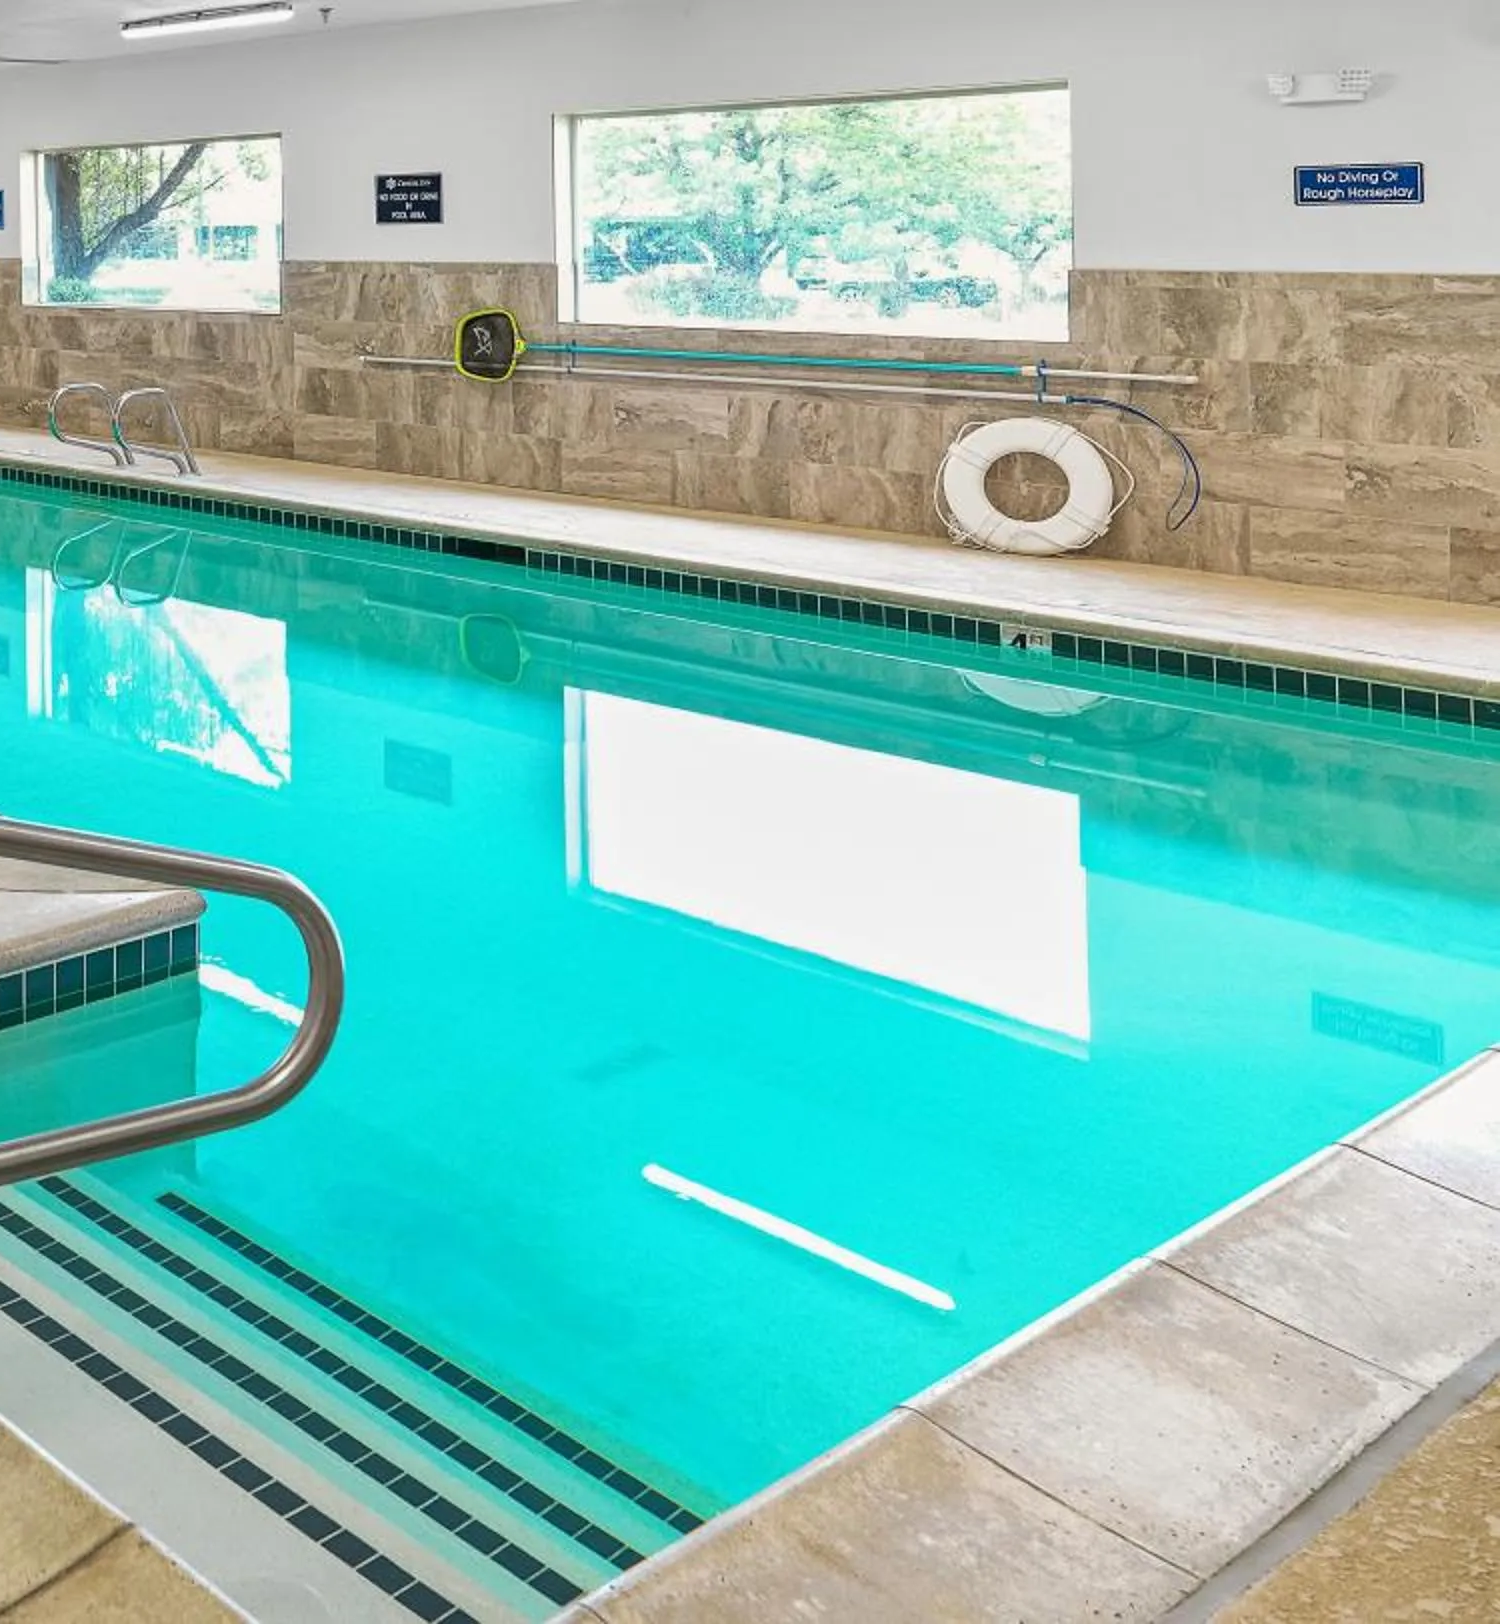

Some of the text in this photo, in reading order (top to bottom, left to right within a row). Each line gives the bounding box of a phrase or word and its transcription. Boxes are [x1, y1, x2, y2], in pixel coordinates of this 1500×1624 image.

[1317, 170, 1399, 184] No Diving Or
[1303, 186, 1415, 200] Rough Horseplay
